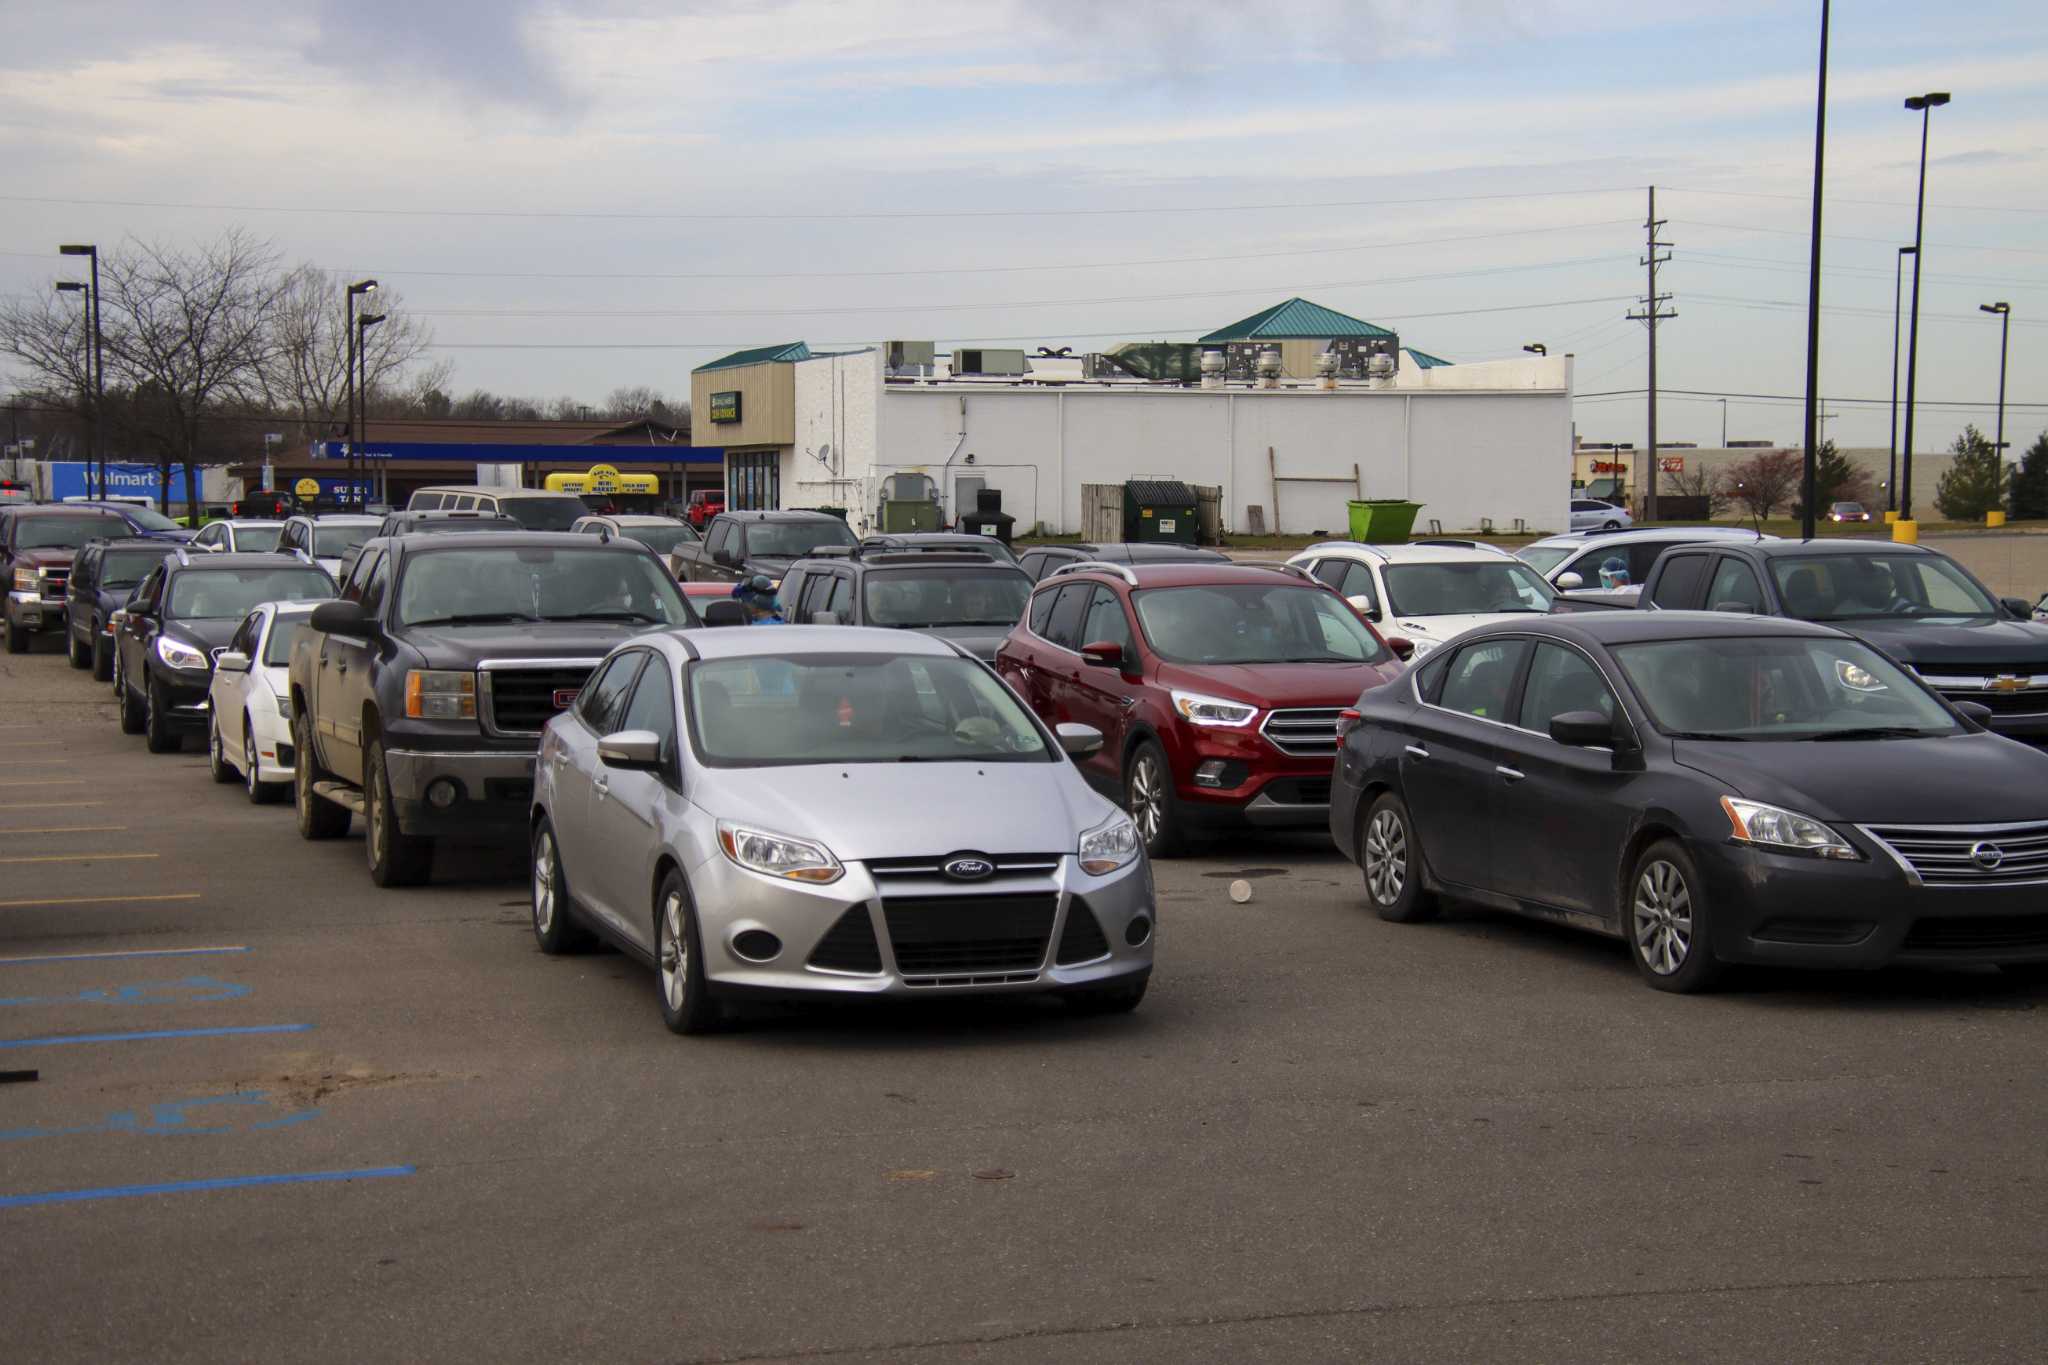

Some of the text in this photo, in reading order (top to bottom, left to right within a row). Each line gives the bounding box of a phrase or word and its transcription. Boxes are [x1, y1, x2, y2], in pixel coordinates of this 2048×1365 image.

[333, 486, 367, 494] SUE
[339, 495, 361, 503] TN
[957, 861, 982, 871] Ford
